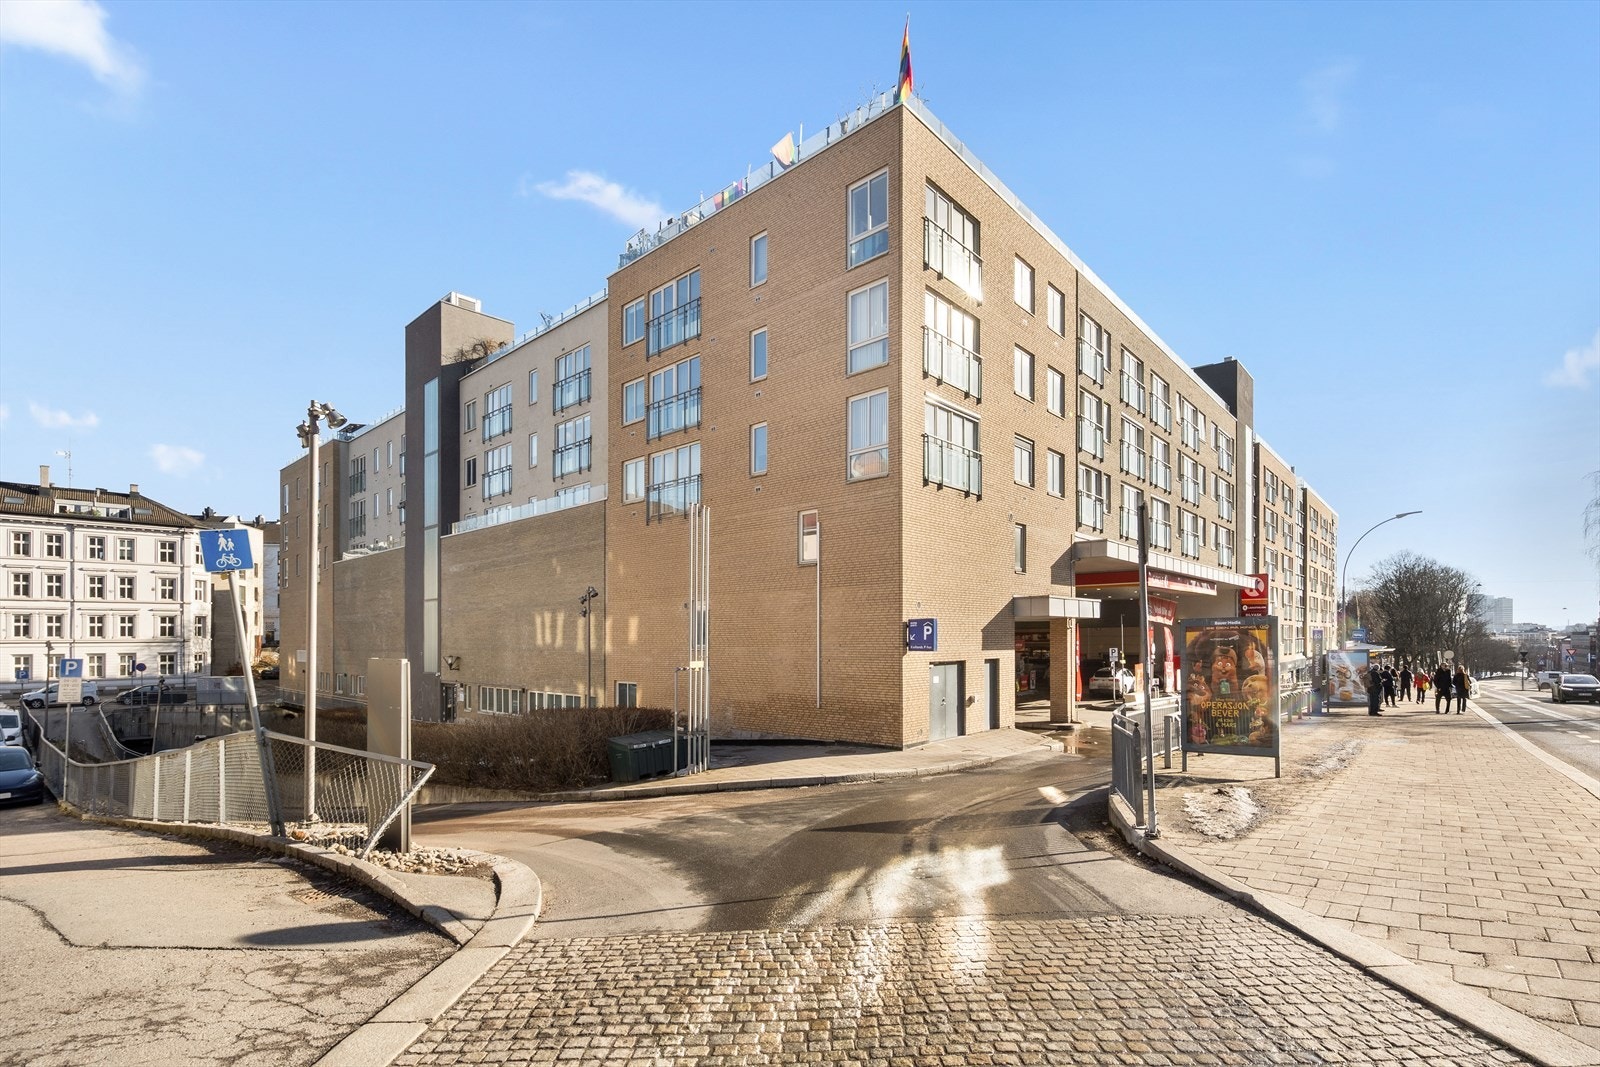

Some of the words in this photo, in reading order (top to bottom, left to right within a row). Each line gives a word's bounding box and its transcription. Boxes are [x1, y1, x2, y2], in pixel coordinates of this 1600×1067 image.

[924, 626, 932, 640] P
[1112, 648, 1117, 656] P
[66, 661, 77, 675] P
[1200, 701, 1249, 710] OPERASJON
[1211, 709, 1240, 717] BEVER
